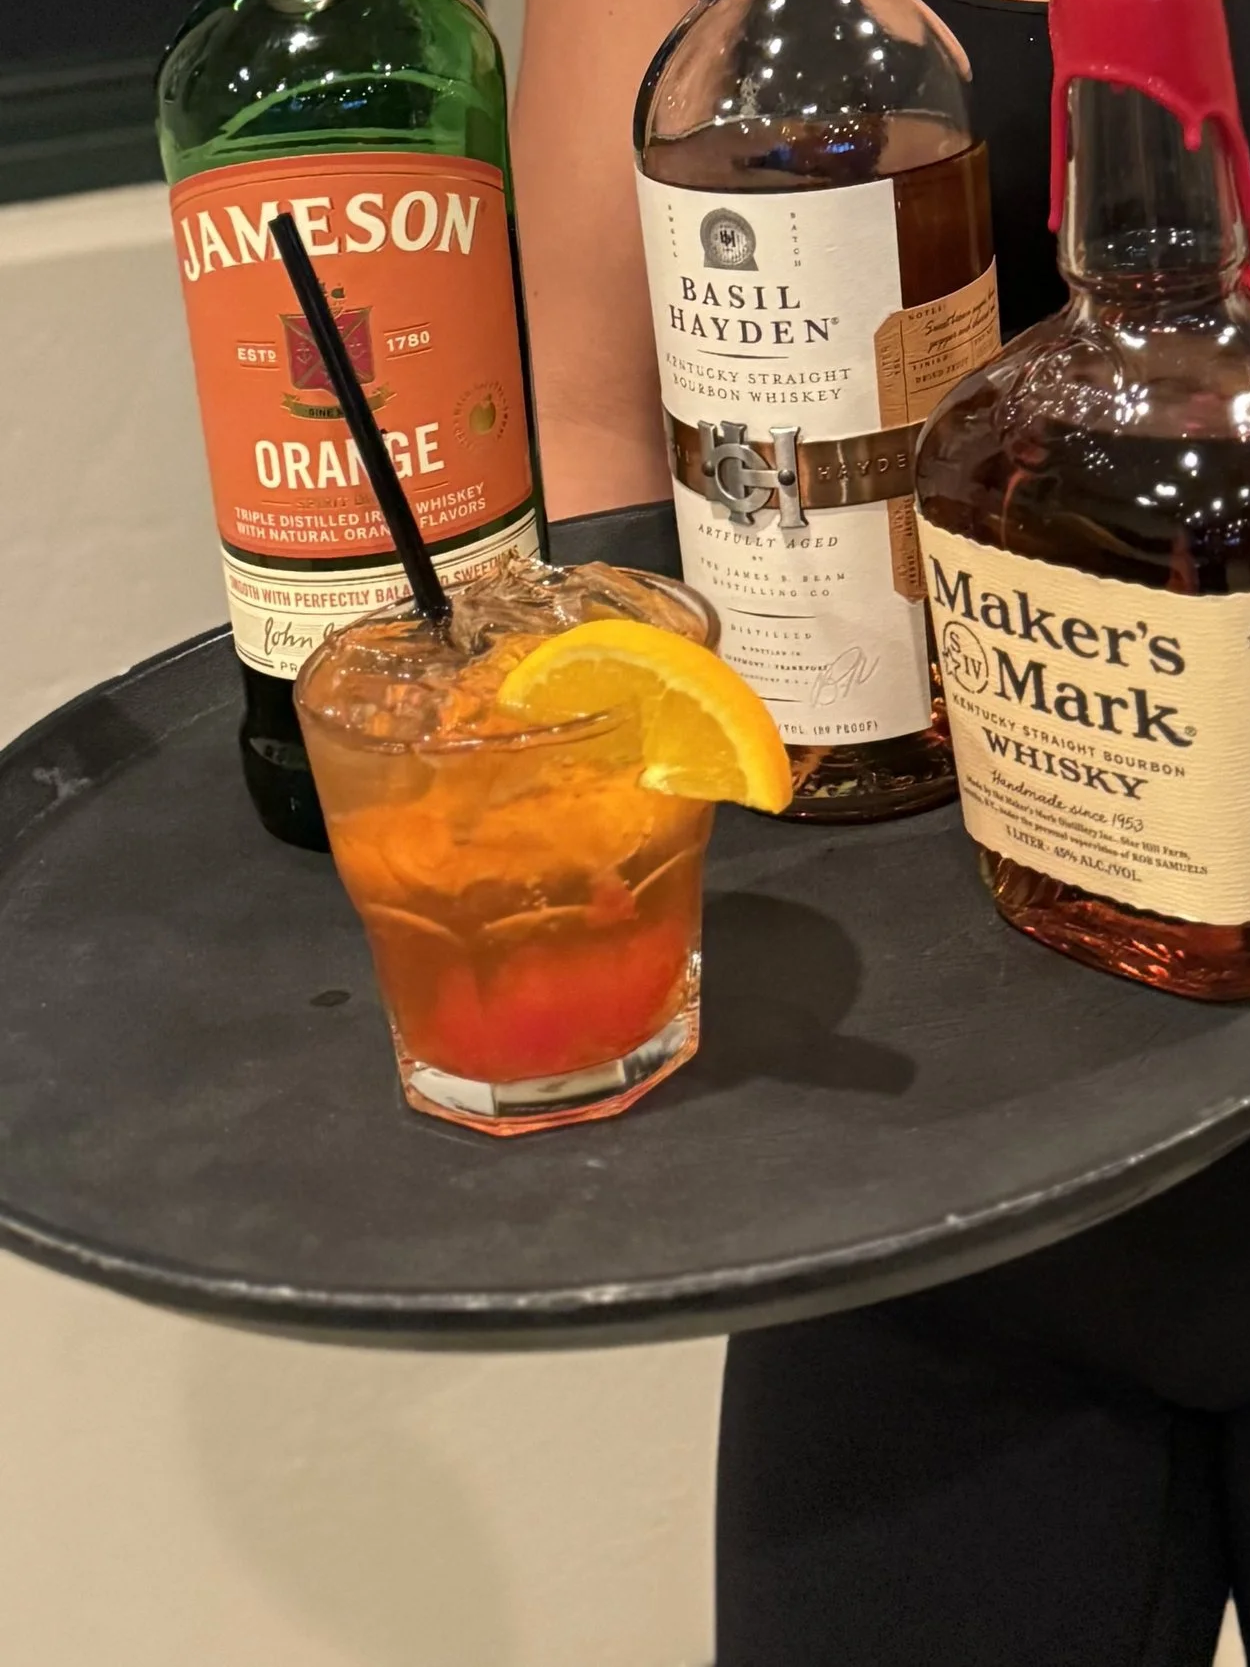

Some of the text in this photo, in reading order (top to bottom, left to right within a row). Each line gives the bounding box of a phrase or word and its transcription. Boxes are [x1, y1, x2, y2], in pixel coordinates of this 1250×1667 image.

[180, 190, 480, 282] JAMESON
[681, 276, 800, 310] BASIL
[386, 330, 431, 352] 1780
[666, 352, 852, 385] KENTUCKY STRAIGHT
[673, 373, 842, 404] BOURBON WHISKEY
[415, 482, 485, 514] WHISKEY
[419, 498, 486, 528] FLAVORS
[234, 506, 276, 526] TRIPLE
[280, 513, 360, 528] DISTILLED
[236, 521, 393, 543] WITH NATURAL ORAN
[698, 523, 839, 549] ARTFULLY AGED
[726, 567, 770, 581] JAMES
[802, 573, 846, 582] BEAM
[262, 588, 291, 606] WITH
[294, 589, 371, 609] PERFECTLY
[929, 554, 1186, 676] Maker's
[264, 617, 314, 656] John
[964, 657, 982, 681] IV
[952, 692, 1186, 777] KENTUCKY STRAIGHT BOURBON
[981, 726, 1148, 800] WHISKY
[991, 769, 1144, 832] Handmade since 1953
[1013, 827, 1045, 851] LITER
[1155, 858, 1208, 874] SAMUELS
